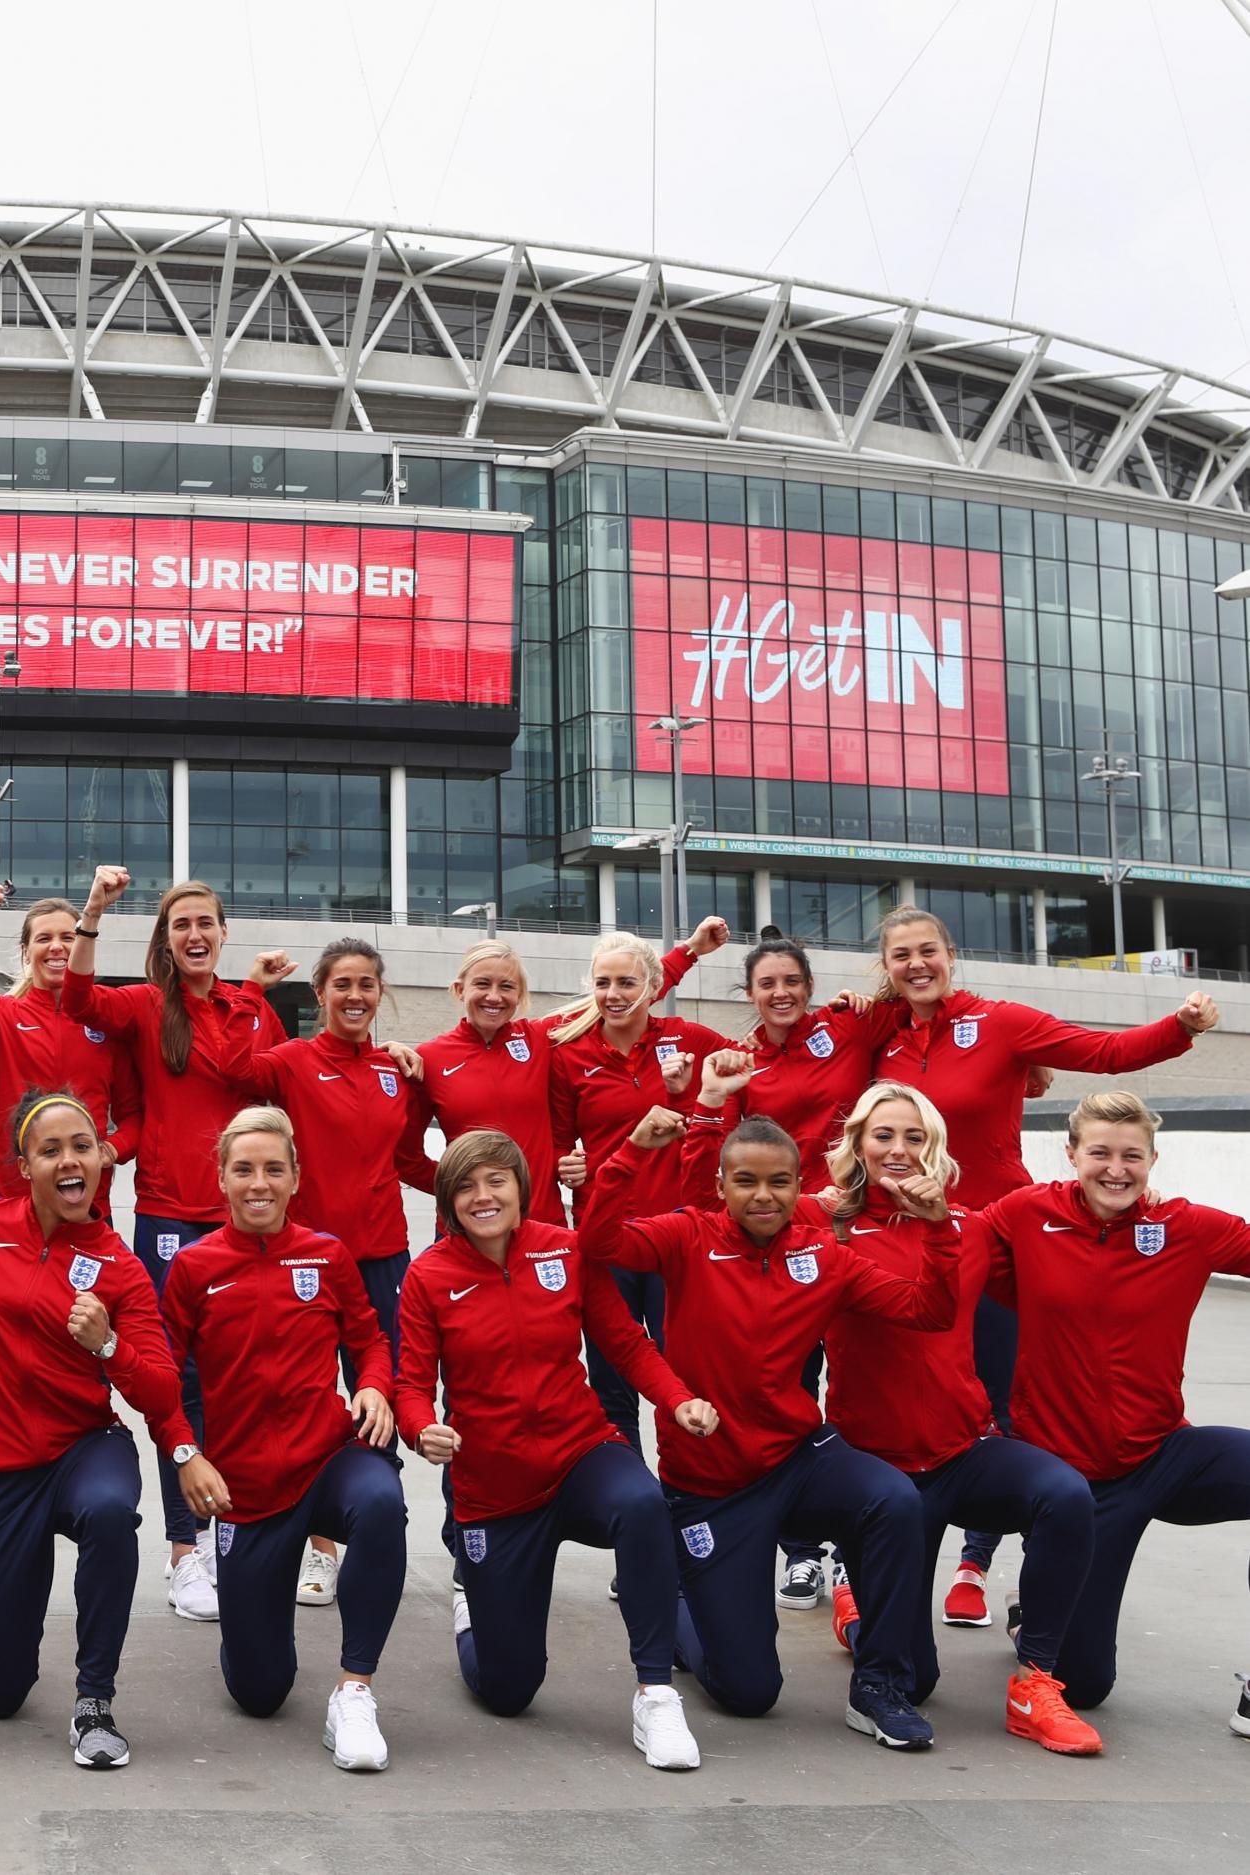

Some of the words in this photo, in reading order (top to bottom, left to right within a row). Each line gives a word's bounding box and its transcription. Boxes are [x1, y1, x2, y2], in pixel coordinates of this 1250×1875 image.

[151, 555, 419, 599] SURRENDER
[63, 615, 303, 654] FOREVER!”
[592, 834, 627, 845] WEMBL
[708, 840, 718, 849] EE
[729, 841, 771, 851] WEMBLEY
[772, 843, 824, 854] CONNECTED
[825, 847, 836, 856] BY
[838, 847, 848, 856] EE
[858, 848, 897, 858] WEMBLEY
[899, 850, 947, 862] CONNECTED
[978, 855, 1014, 867] WEMBLEY
[1015, 858, 1060, 870] CONNECTED
[530, 1247, 572, 1259] VAUXHALL
[284, 1258, 330, 1266] VAUXHALL
